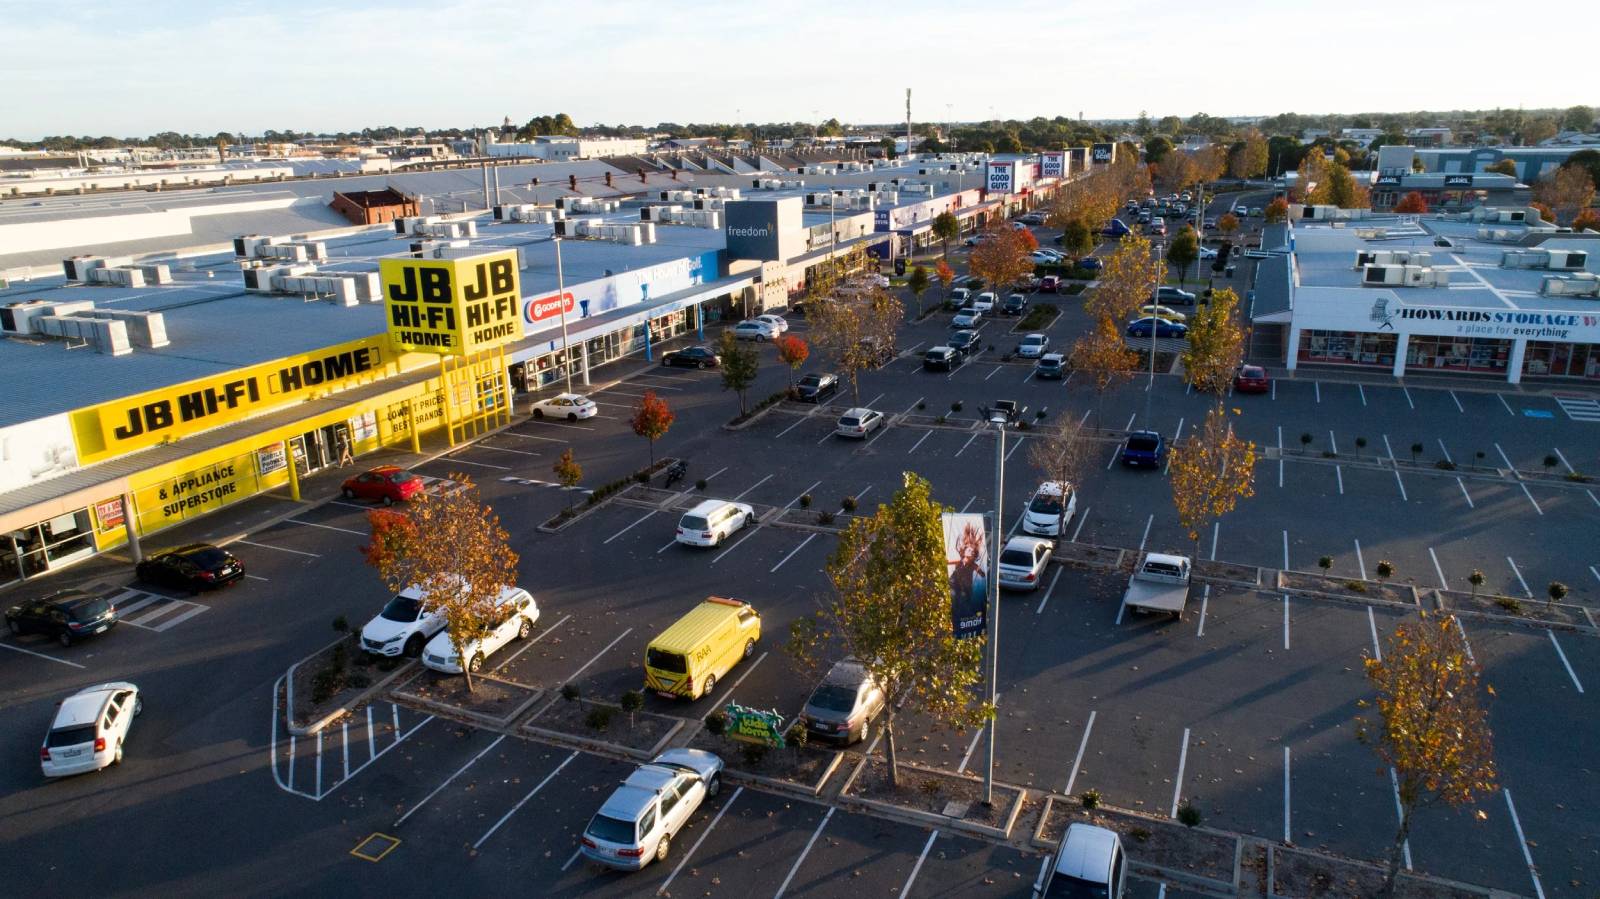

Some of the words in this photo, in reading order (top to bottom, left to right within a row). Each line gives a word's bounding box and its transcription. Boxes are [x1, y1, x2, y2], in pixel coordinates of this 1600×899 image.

[990, 174, 1010, 182] GOOD
[991, 182, 1009, 190] GUYS
[728, 225, 768, 237] freedom
[388, 266, 453, 304] JB
[463, 258, 515, 302] JB
[1493, 312, 1579, 327] STORAGE
[400, 331, 451, 347] HOME
[474, 322, 514, 345] HOME
[1456, 325, 1462, 333] a
[1465, 324, 1493, 335] place
[1496, 324, 1510, 334] for
[1513, 326, 1568, 339] everything
[115, 398, 175, 441] JB
[279, 347, 371, 394] HOME
[388, 401, 419, 421] LOWET
[420, 393, 447, 410] PRICES
[415, 408, 444, 425] BRANDS
[159, 489, 168, 501] &
[173, 465, 235, 496] APPLIANCE
[163, 481, 237, 518] SUPERSTORE
[739, 721, 770, 737] home
